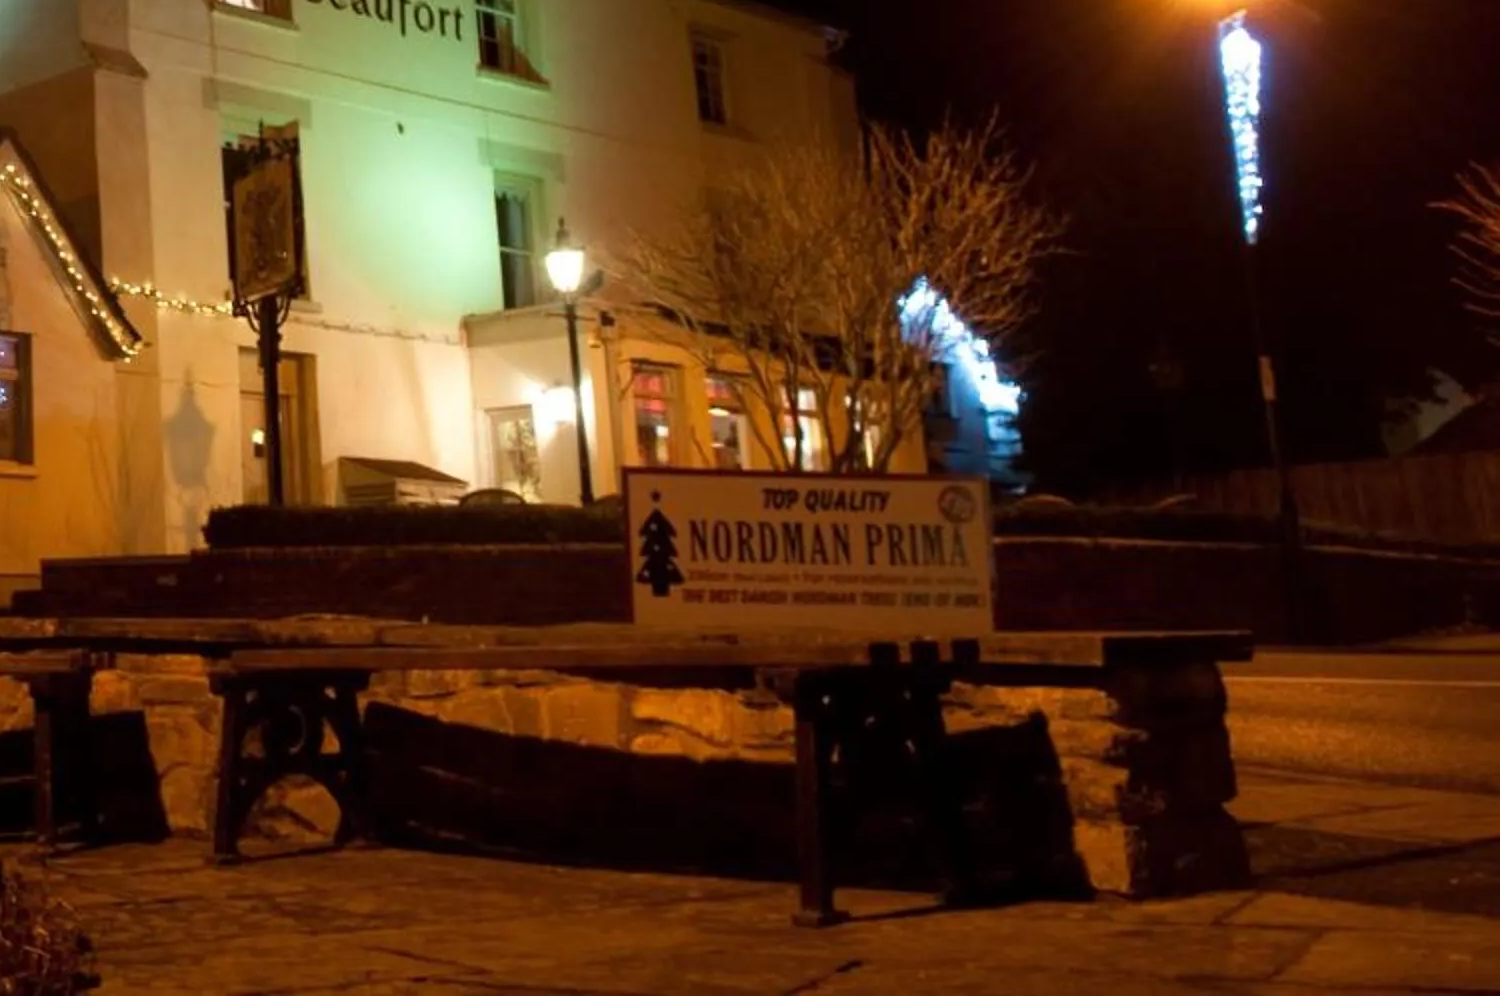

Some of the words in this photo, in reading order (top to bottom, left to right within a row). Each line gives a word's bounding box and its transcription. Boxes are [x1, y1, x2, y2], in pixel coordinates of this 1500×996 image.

[761, 488, 800, 510] TOP
[804, 489, 891, 514] QUALITY
[688, 519, 852, 566] NORDMAN
[864, 522, 970, 567] PRIMA
